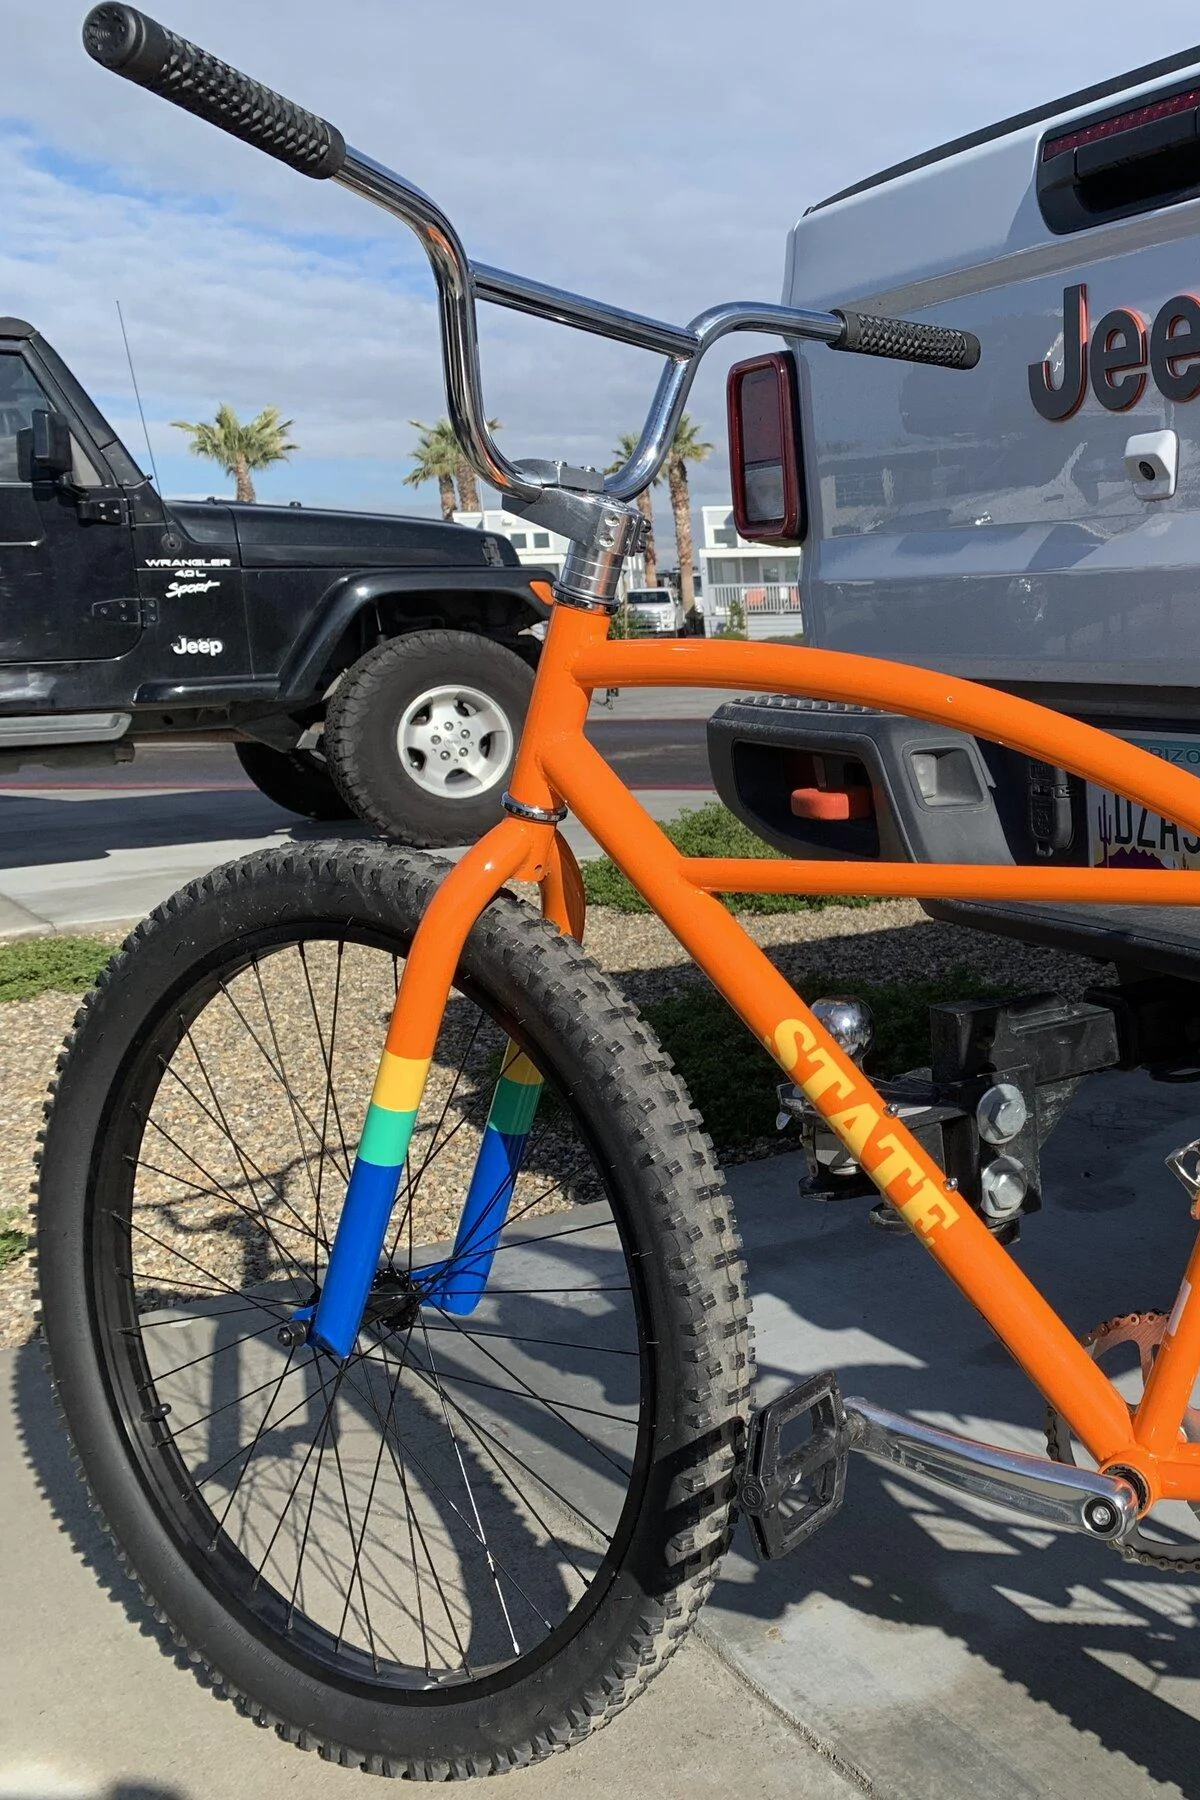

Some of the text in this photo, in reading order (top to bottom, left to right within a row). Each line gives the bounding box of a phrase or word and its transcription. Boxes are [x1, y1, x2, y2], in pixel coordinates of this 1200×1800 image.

[145, 559, 231, 567] WRANGLER
[165, 580, 221, 598] Sport
[171, 635, 223, 656] Jeep
[766, 1019, 960, 1245] STATE
